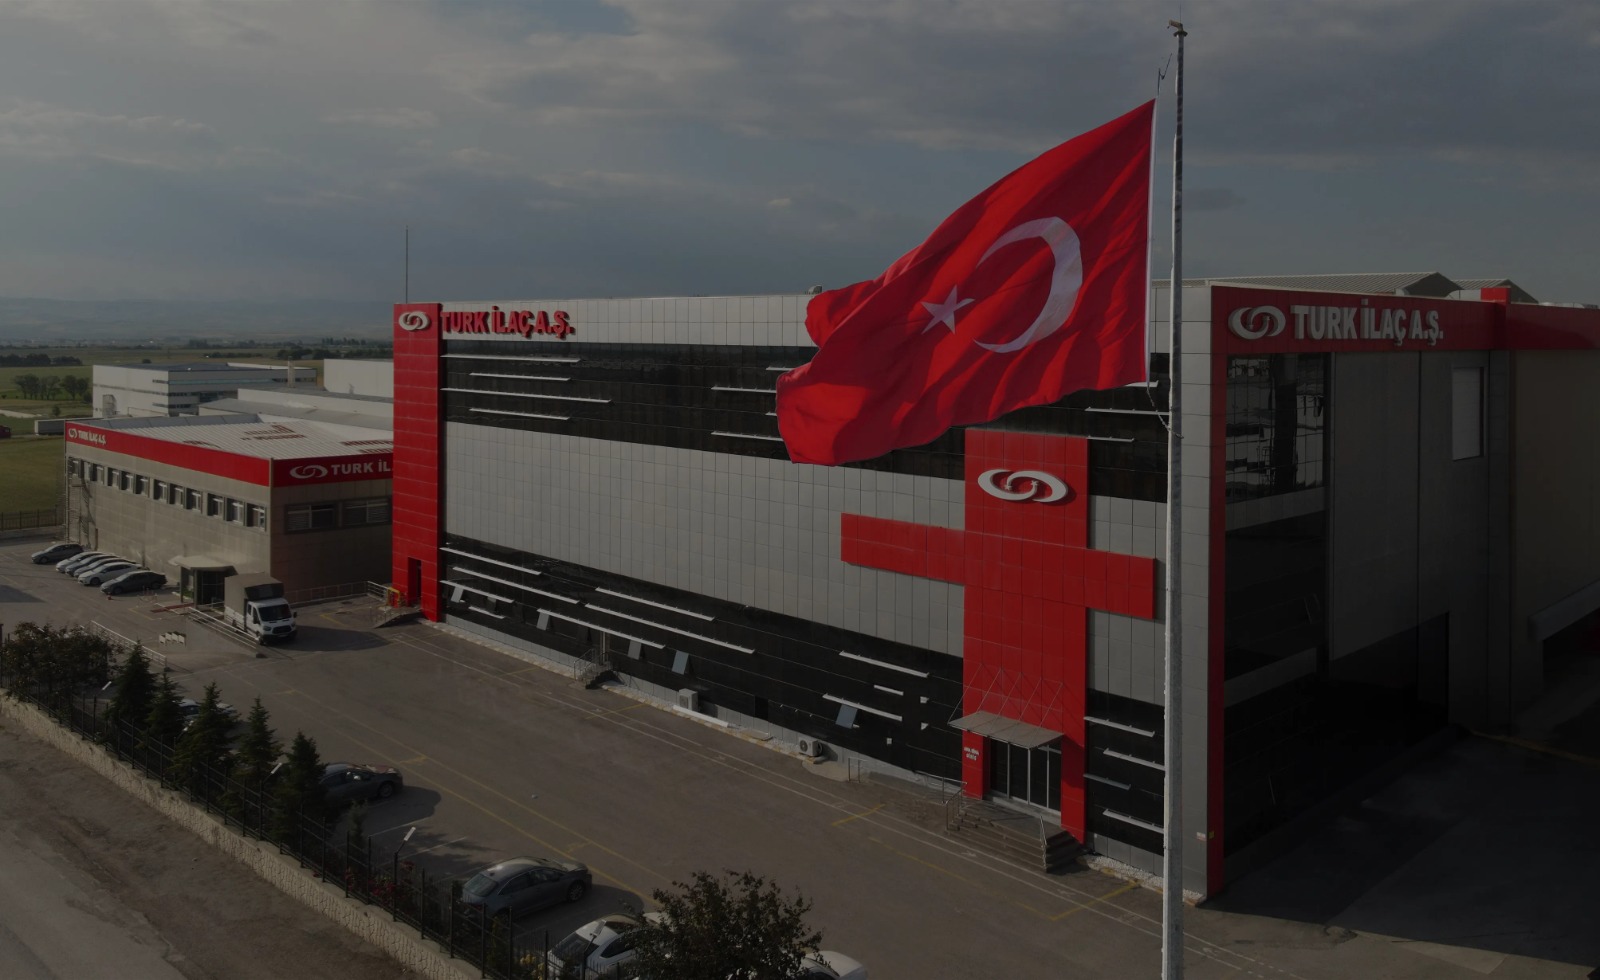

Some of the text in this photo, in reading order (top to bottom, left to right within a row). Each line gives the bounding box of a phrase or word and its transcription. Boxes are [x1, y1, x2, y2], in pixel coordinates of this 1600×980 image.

[440, 311, 490, 334] TURK
[1290, 304, 1358, 339] TURK
[330, 459, 393, 476] TURK İL
